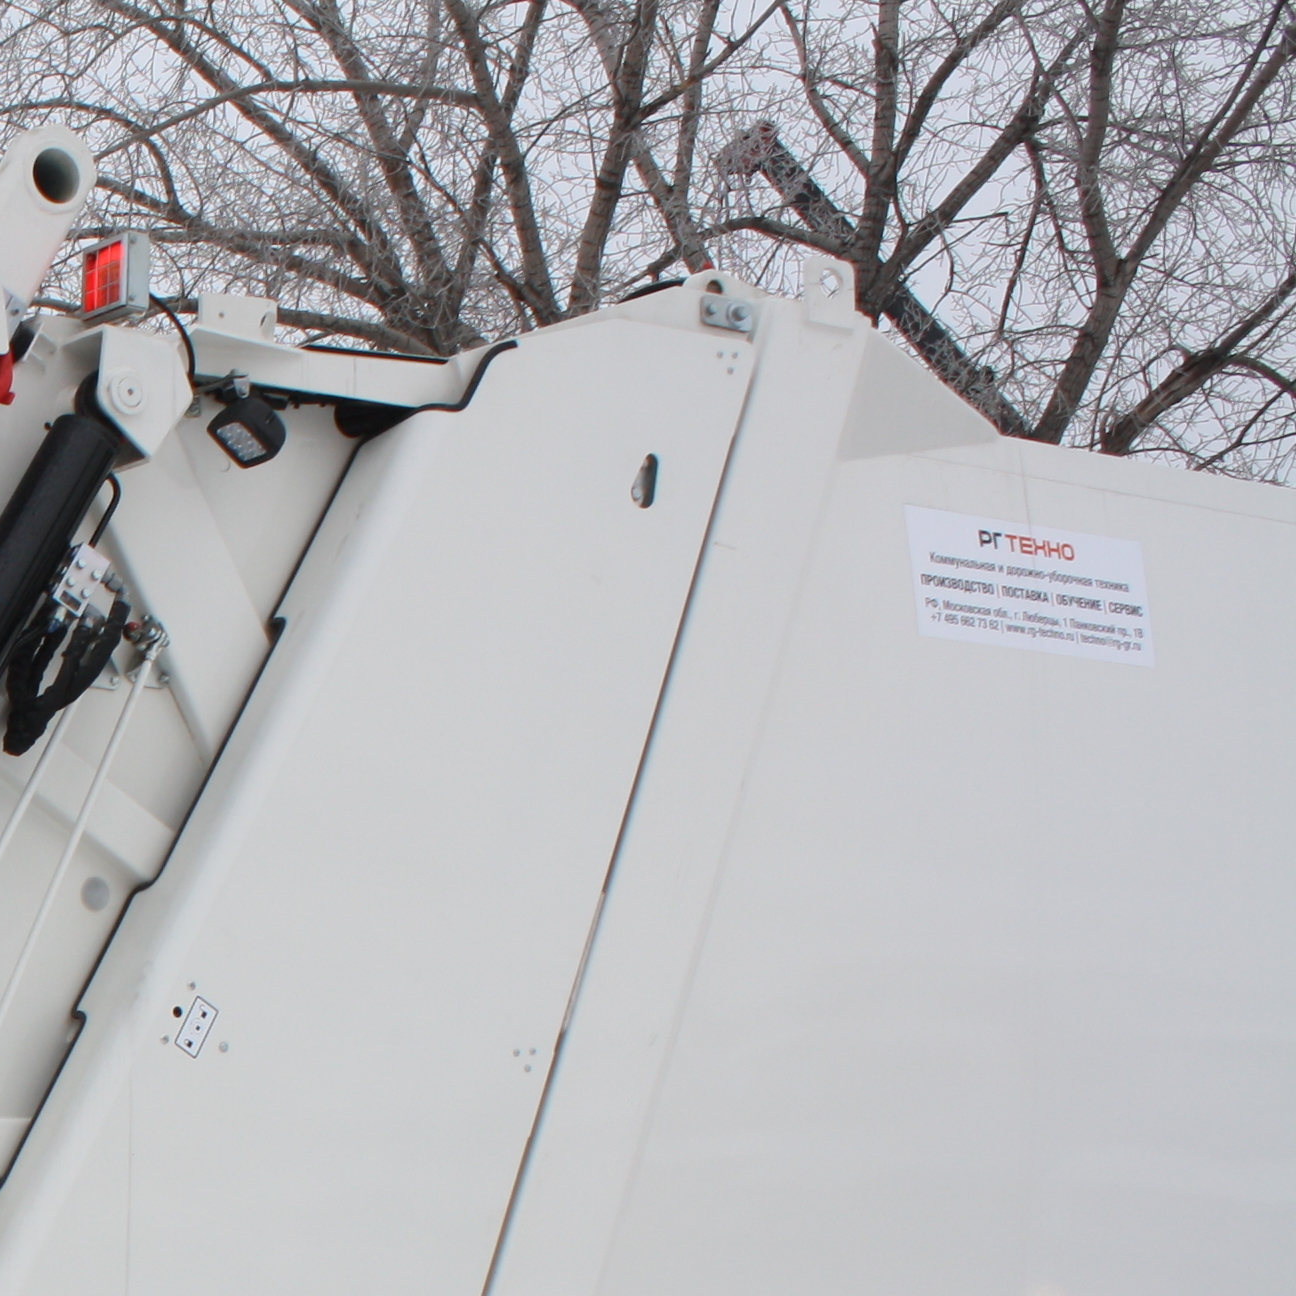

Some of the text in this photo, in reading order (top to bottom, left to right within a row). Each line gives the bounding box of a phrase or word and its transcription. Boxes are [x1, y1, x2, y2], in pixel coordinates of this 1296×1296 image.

[978, 530, 1076, 561] РГ ТЕХНО
[928, 552, 995, 572] Коммунальная
[1094, 579, 1129, 593] техника
[920, 574, 1143, 617] ПРОИЗВОДСТВО ПОСТАВКА ОБУЧЕНИЕ СЕРВИС
[942, 600, 991, 616] Московская
[929, 611, 942, 622] +7
